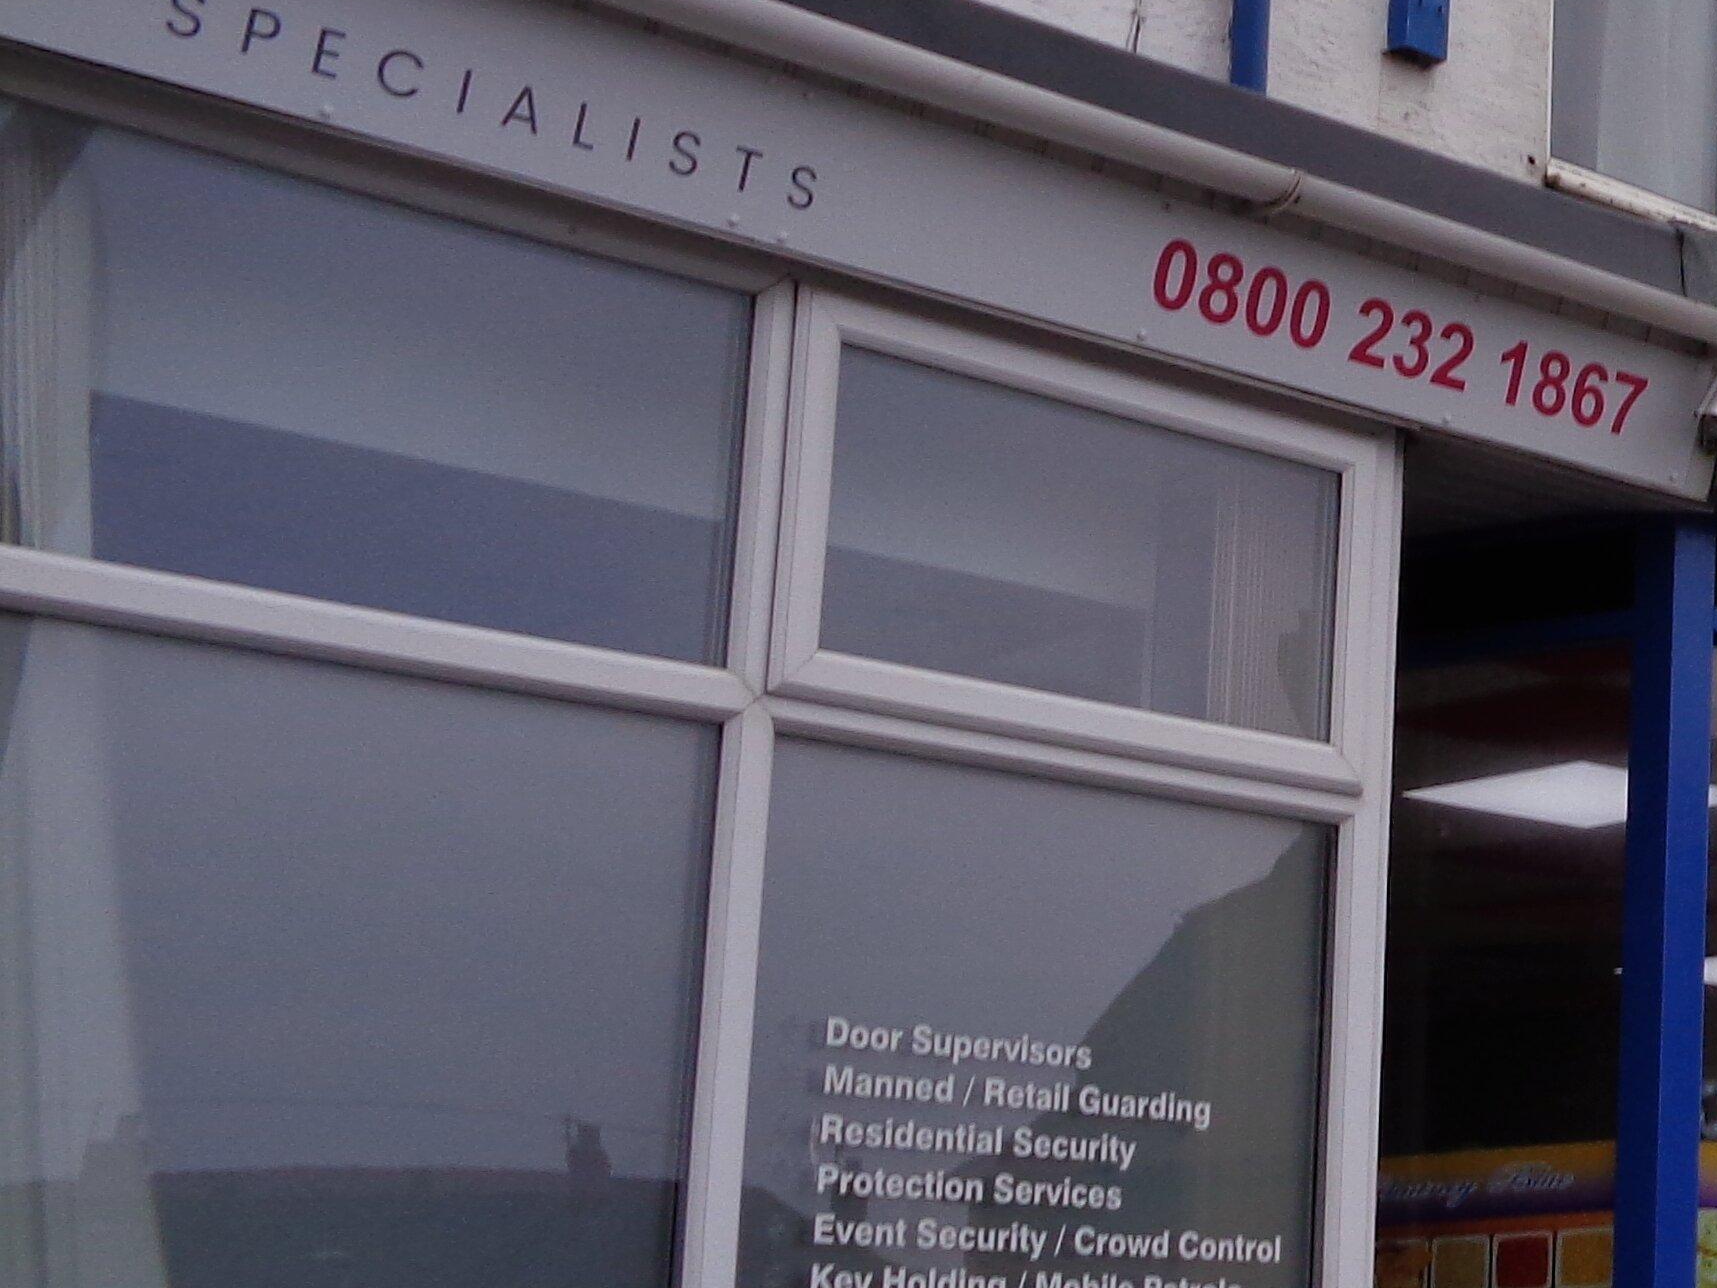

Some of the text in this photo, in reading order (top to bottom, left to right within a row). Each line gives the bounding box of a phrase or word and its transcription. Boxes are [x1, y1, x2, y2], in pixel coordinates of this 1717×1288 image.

[1152, 237, 1650, 436] 0800 232 1867
[826, 1015, 1093, 1071] Door Supervisors
[823, 1065, 1212, 1130] Manned / Retail Guarding
[818, 1113, 1137, 1171] Residential Security
[816, 1162, 1123, 1211] Protection Services
[812, 1213, 1282, 1265] Event Security / Crowd Control
